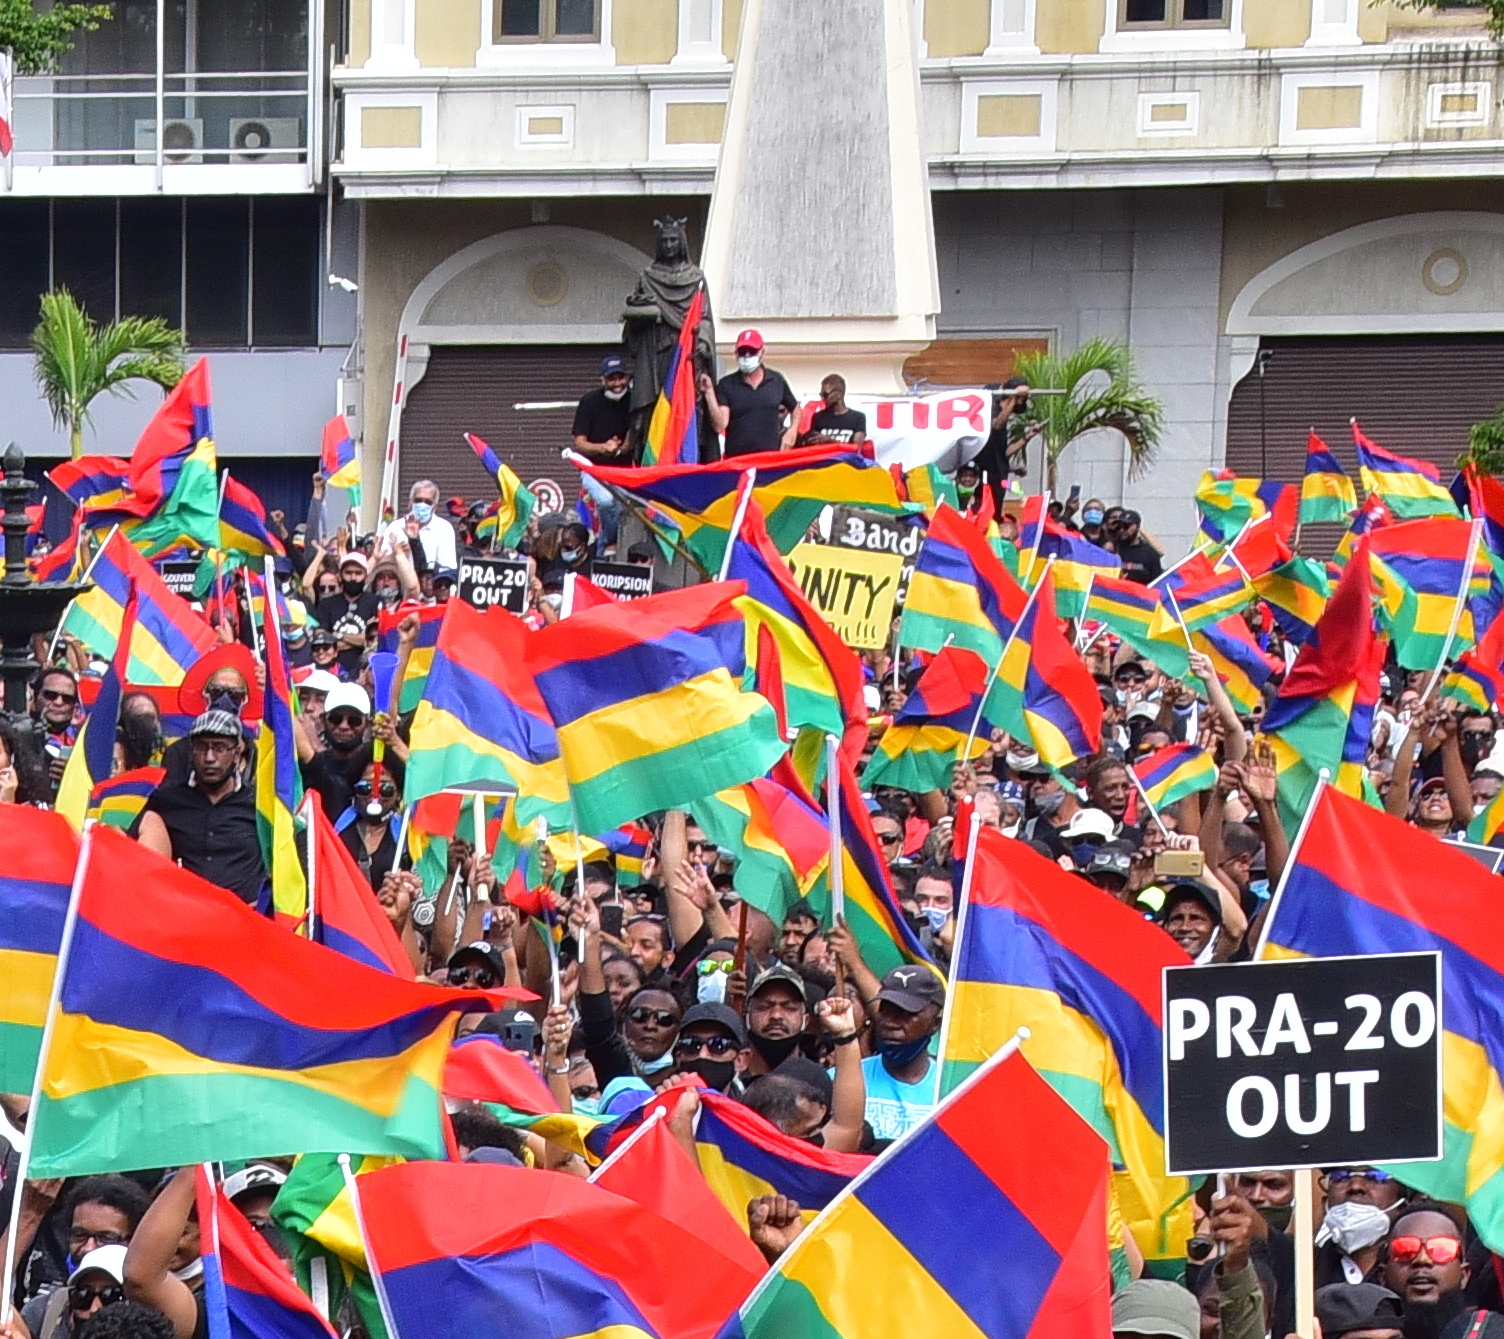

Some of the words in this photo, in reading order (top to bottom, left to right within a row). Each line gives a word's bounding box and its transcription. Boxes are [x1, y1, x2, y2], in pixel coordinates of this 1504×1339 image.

[840, 518, 924, 557] Band
[461, 565, 526, 588] PRA-20
[472, 588, 512, 606] OUT
[790, 559, 891, 619] NITY
[1169, 990, 1436, 1061] PRA-20
[1225, 1069, 1380, 1138] OUT
